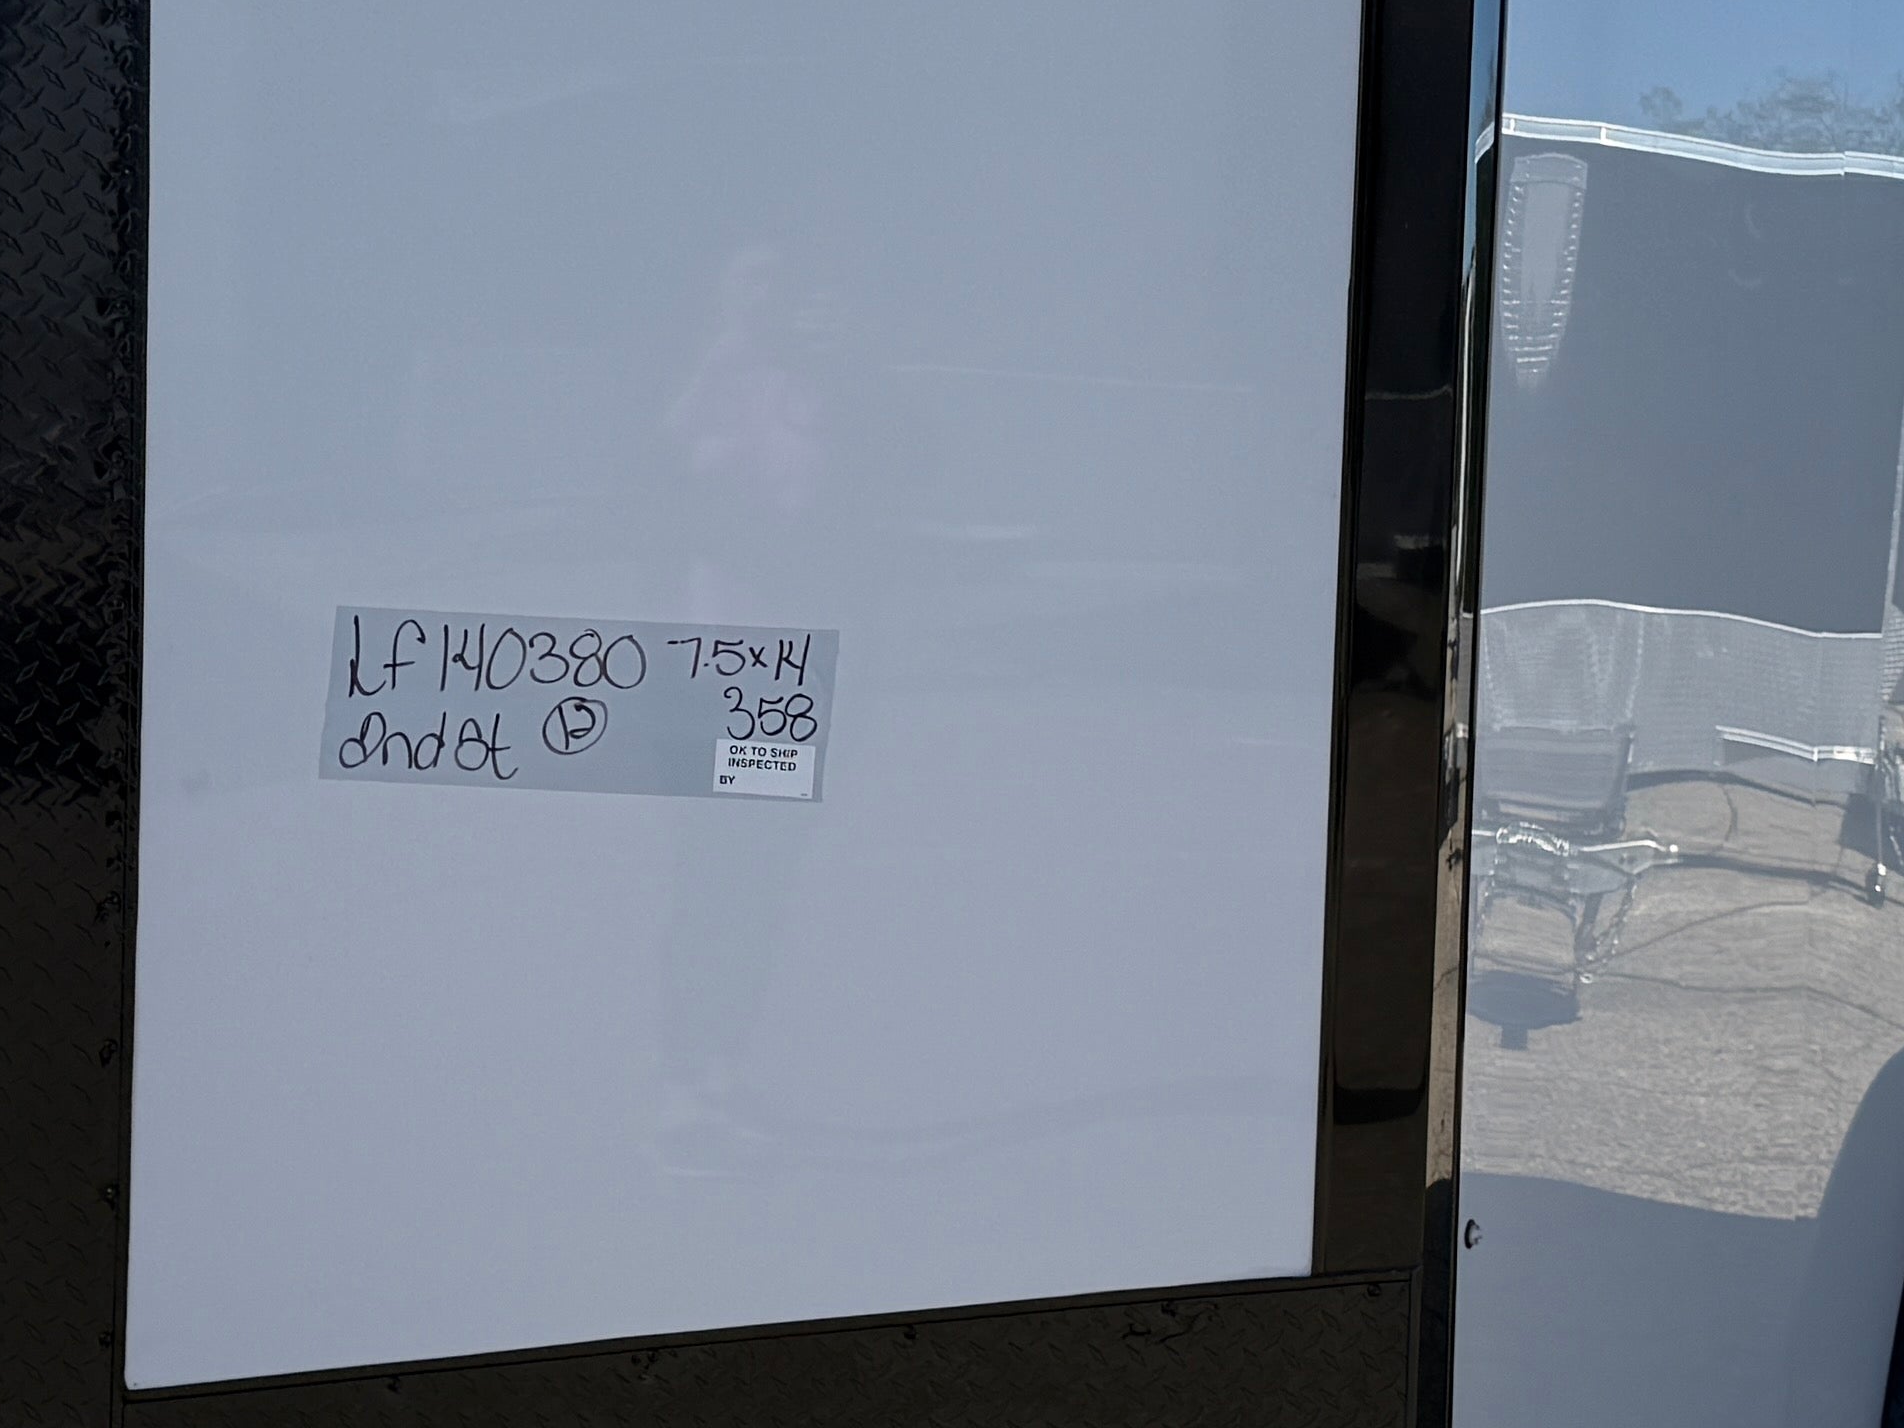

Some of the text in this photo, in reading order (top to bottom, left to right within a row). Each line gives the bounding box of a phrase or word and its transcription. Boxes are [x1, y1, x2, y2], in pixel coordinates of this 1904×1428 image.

[723, 686, 818, 742] 358
[729, 745, 798, 759] OK TO SHIP
[728, 758, 797, 772] INSPECTED
[719, 775, 736, 785] BY
